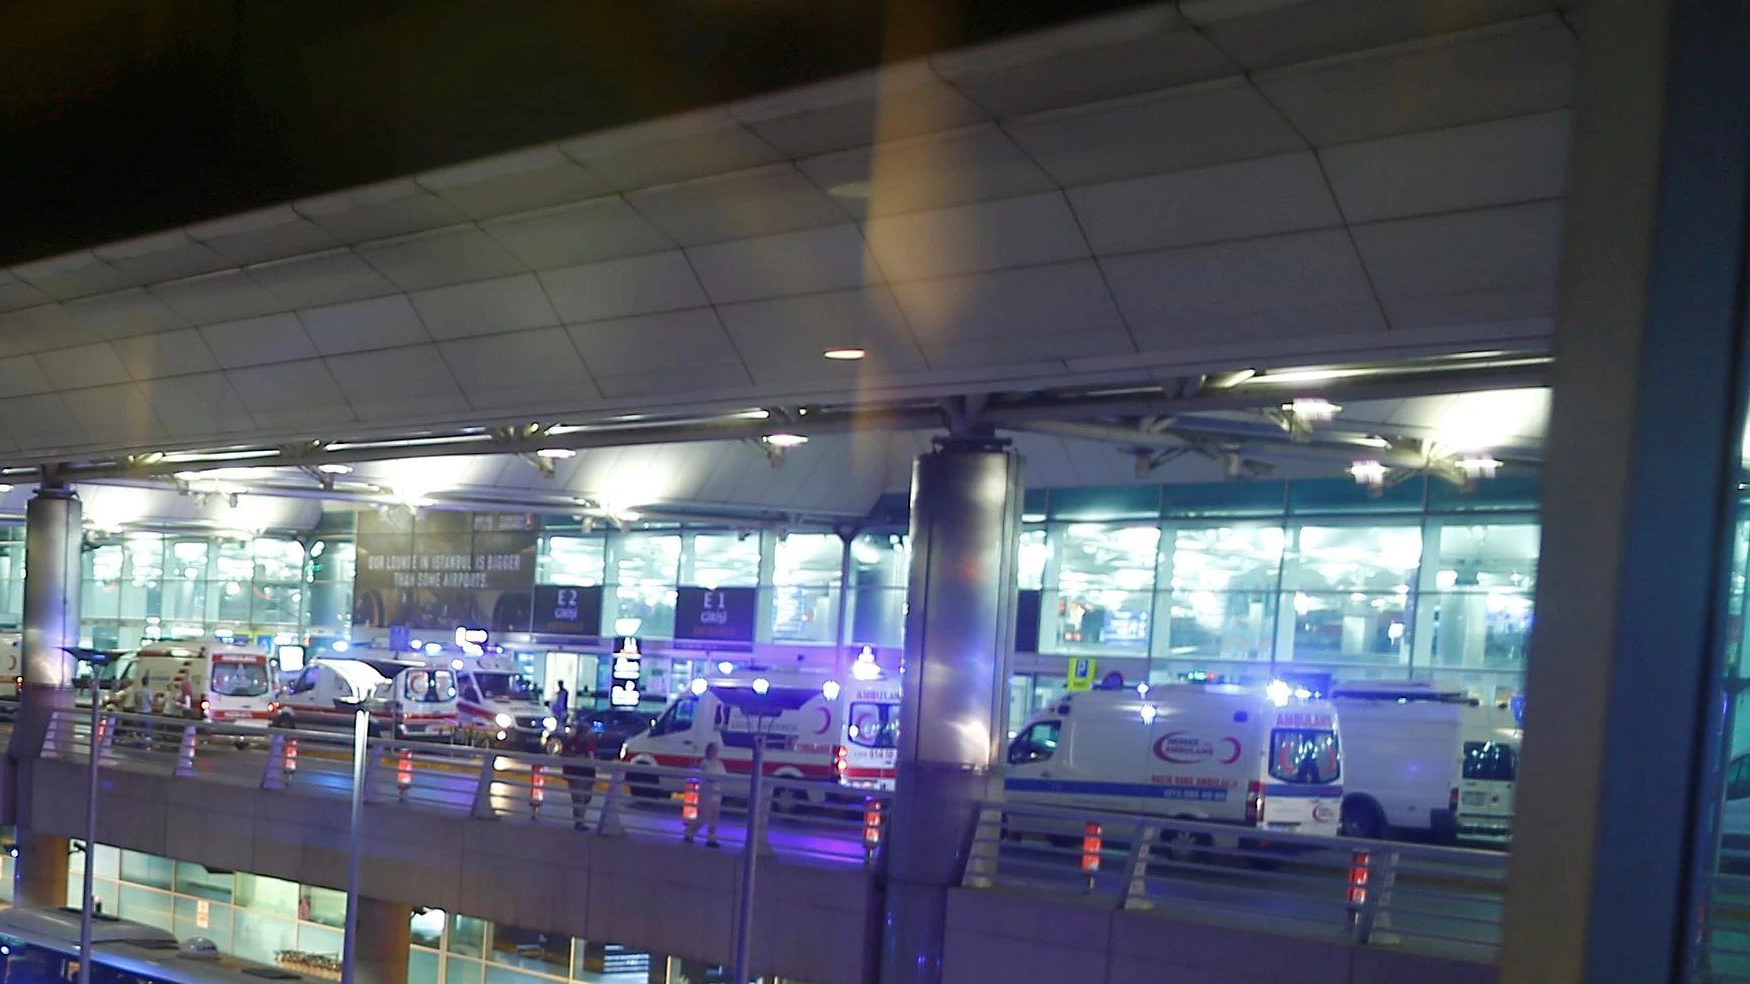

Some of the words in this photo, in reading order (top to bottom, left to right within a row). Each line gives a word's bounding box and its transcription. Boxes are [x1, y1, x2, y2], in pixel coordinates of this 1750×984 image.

[368, 554, 384, 569] OUR
[386, 555, 417, 569] LOUNGE
[419, 555, 430, 569] IN
[475, 555, 485, 569] IS
[487, 555, 521, 569] BIGGER
[394, 572, 415, 587] THAN
[417, 573, 441, 587] SOME
[557, 588, 566, 605] E
[569, 588, 578, 606] 2
[703, 592, 713, 608] E
[717, 592, 725, 608] 1
